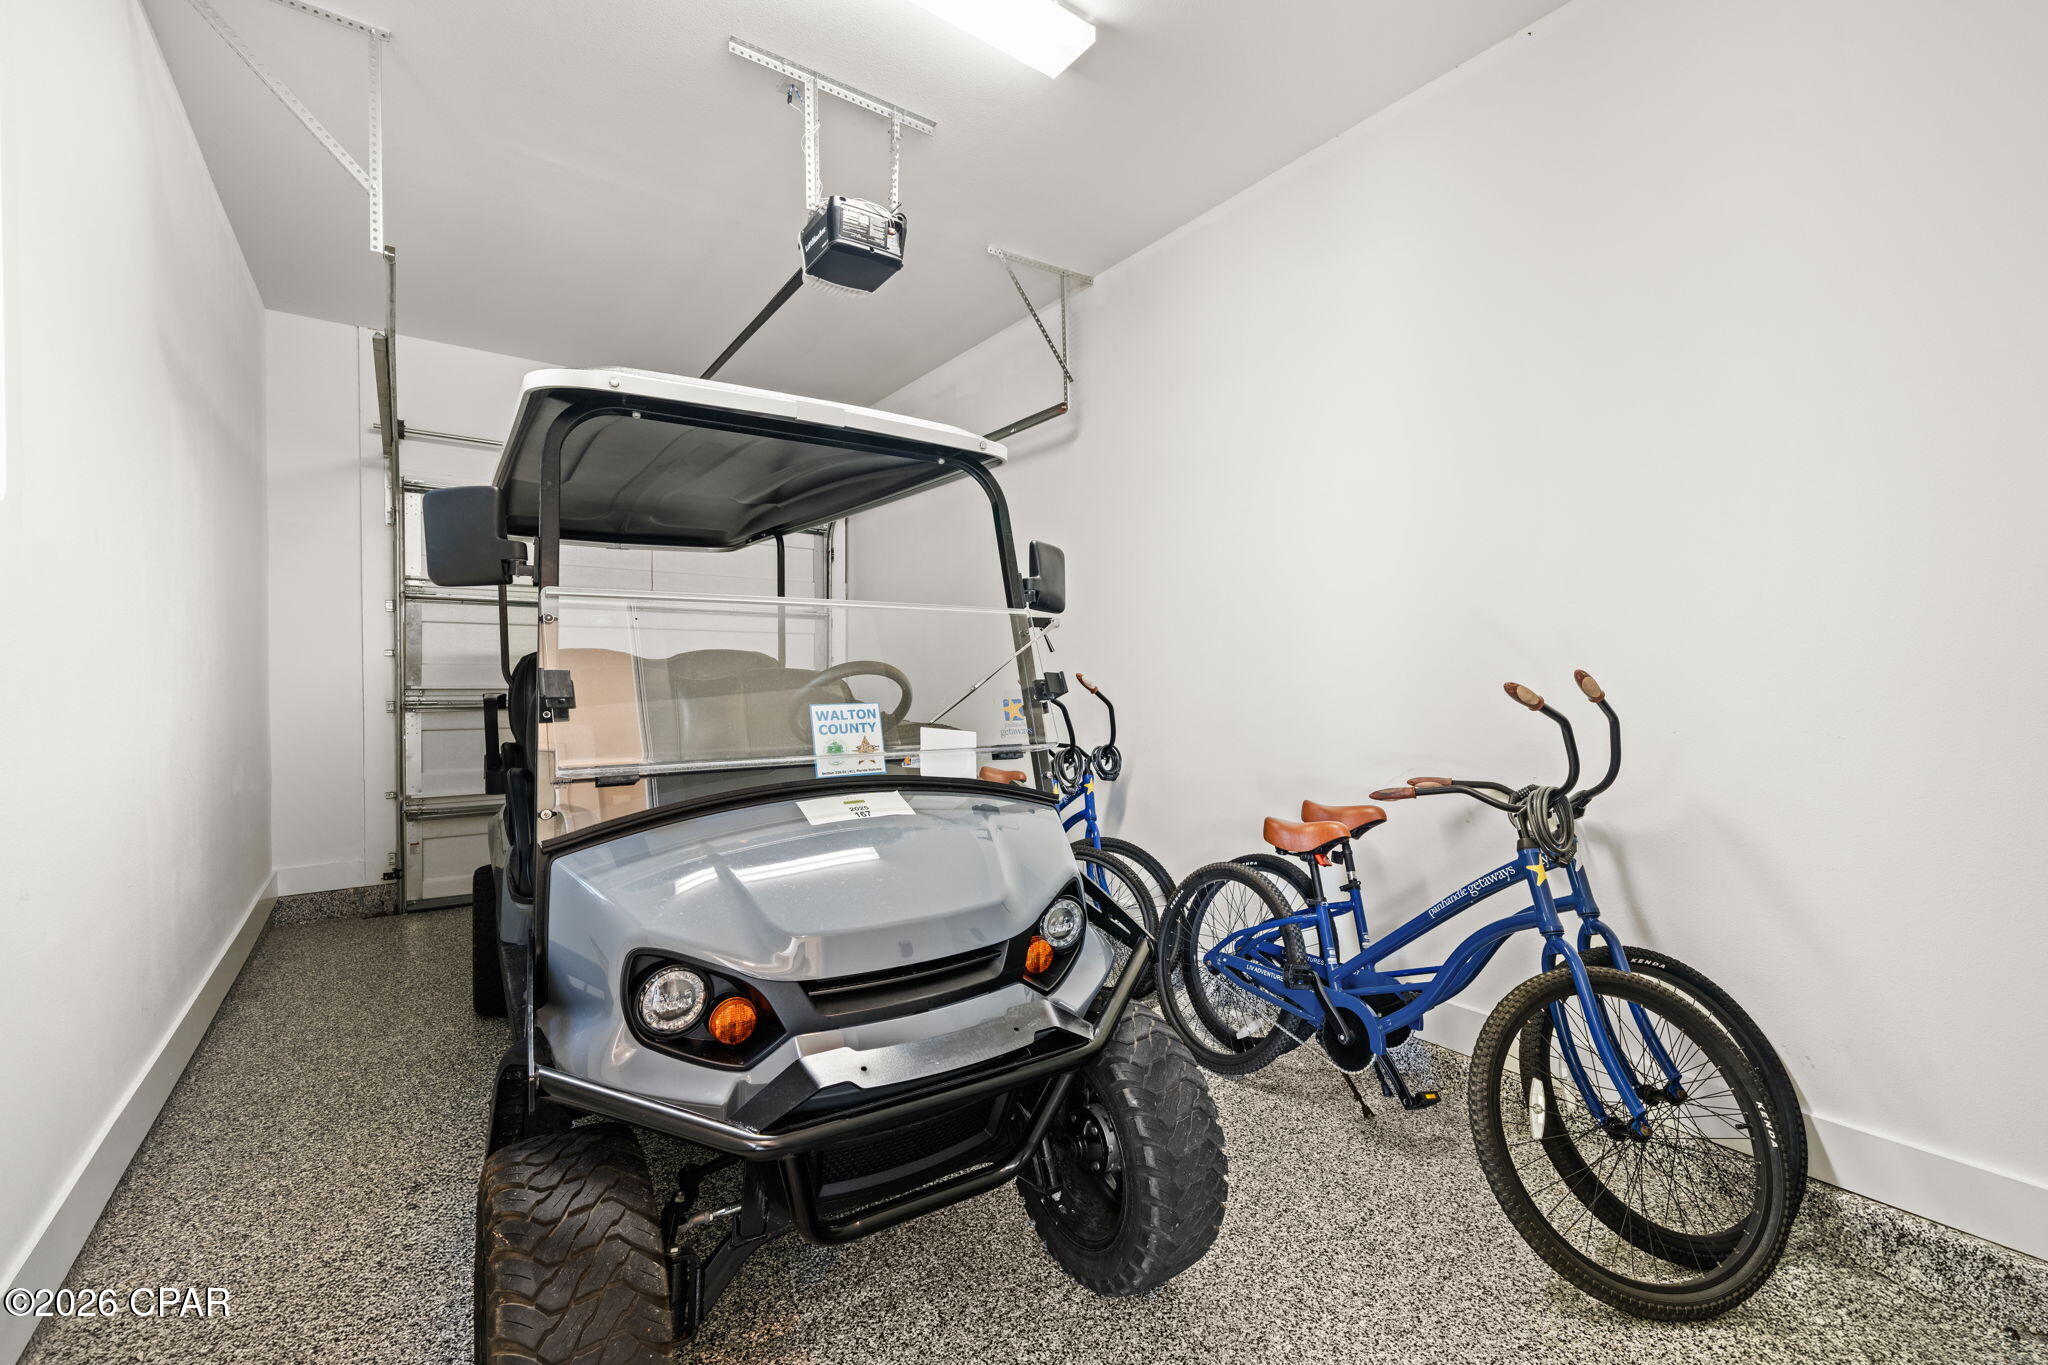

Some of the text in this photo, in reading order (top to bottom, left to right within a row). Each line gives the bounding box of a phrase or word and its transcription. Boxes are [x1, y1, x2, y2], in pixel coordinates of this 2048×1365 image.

[815, 709, 877, 721] WALTON
[818, 722, 876, 735] COUNTY
[1428, 865, 1516, 919] panhandle getaways
[1630, 958, 1666, 969] KENDA
[1253, 967, 1284, 982] ADVENTURE
[1755, 1101, 1778, 1148] KENDA
